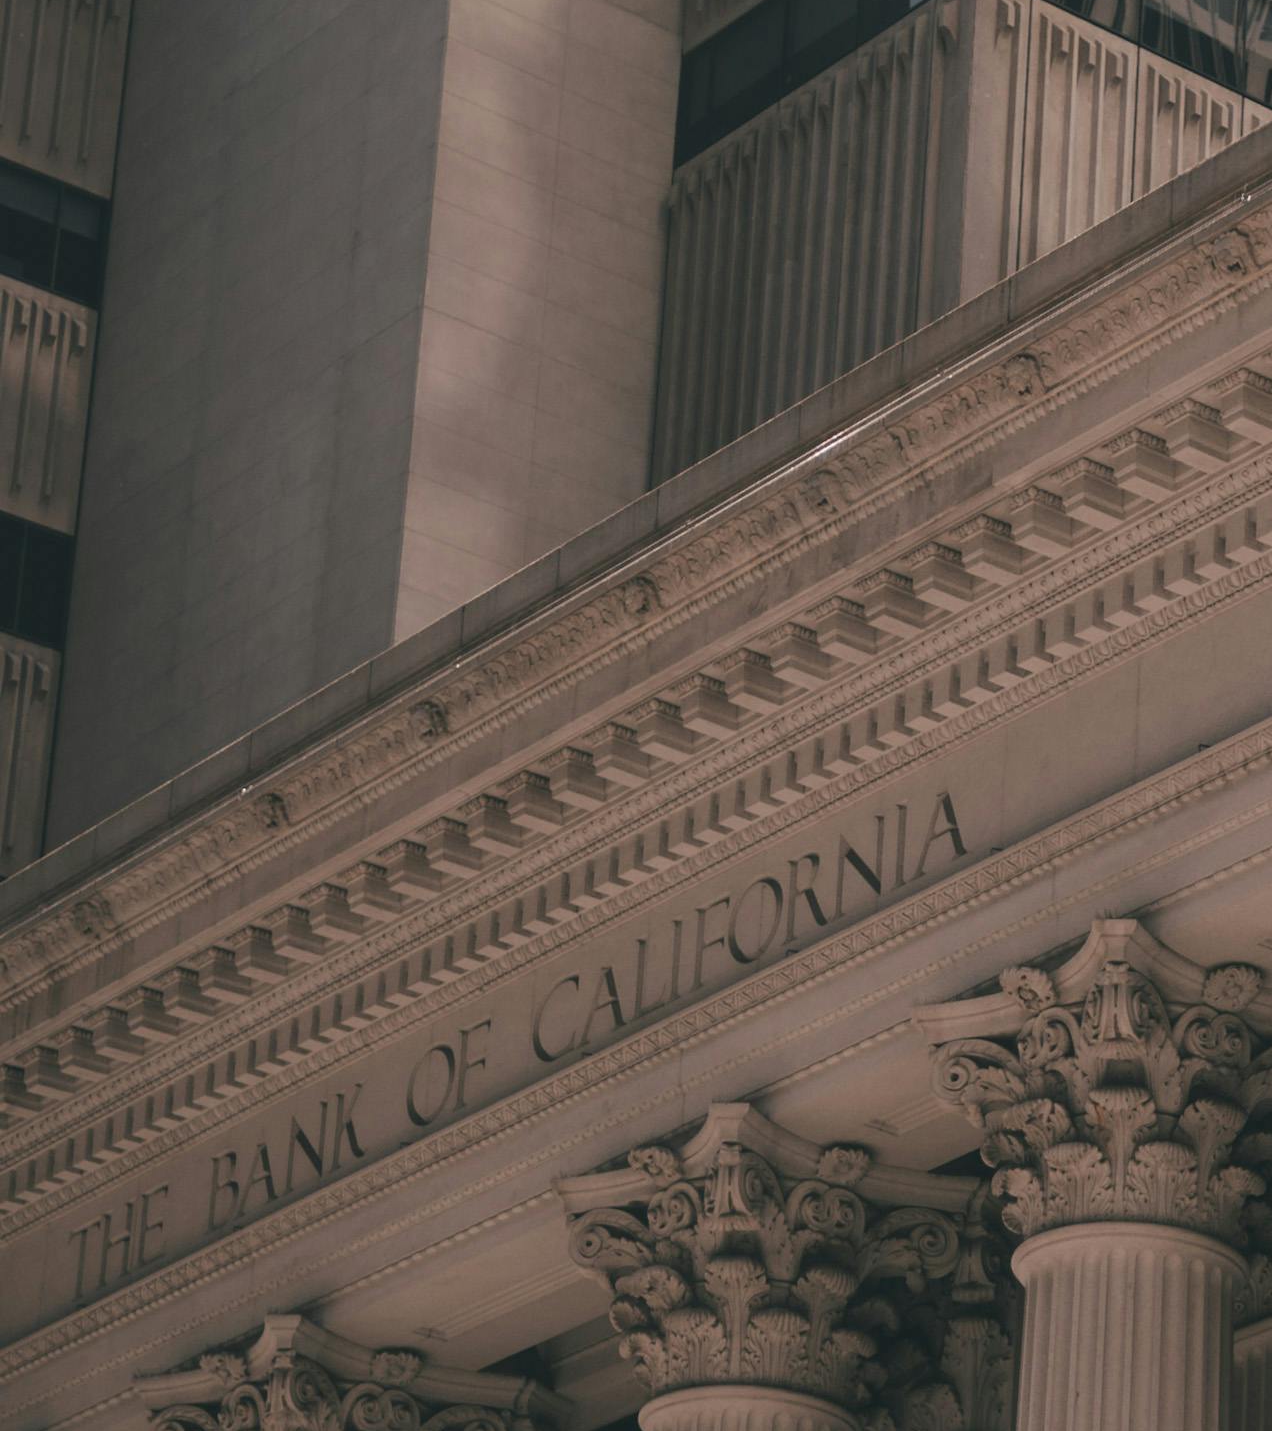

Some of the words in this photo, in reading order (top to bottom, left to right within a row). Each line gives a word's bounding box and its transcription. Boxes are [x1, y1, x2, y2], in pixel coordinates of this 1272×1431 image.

[66, 1184, 169, 1301] THE
[207, 1082, 367, 1232] BANK
[406, 1018, 492, 1126] OF
[532, 791, 968, 1063] CALIFORNIA
